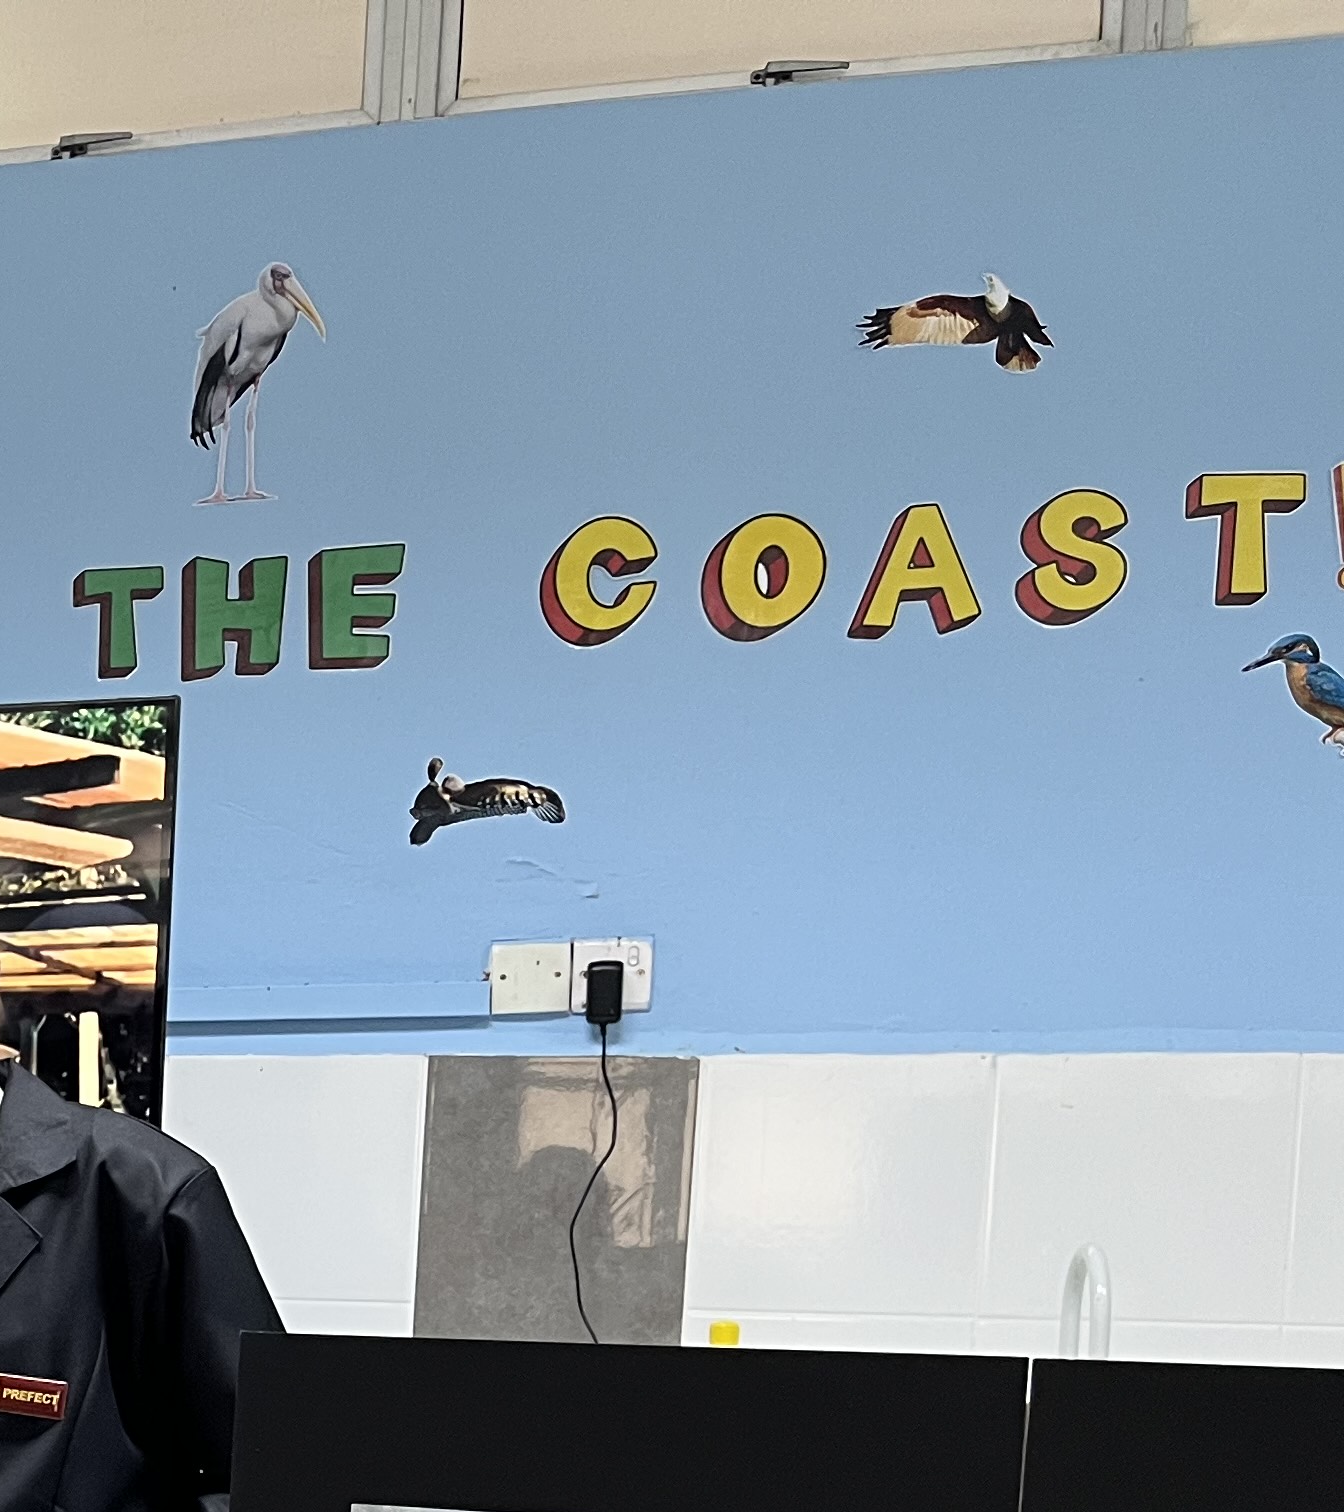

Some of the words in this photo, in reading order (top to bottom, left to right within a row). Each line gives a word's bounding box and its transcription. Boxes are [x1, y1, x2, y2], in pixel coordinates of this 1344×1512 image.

[72, 542, 407, 683] THE
[538, 460, 1344, 648] COAST
[2, 1387, 60, 1406] PREFECT
